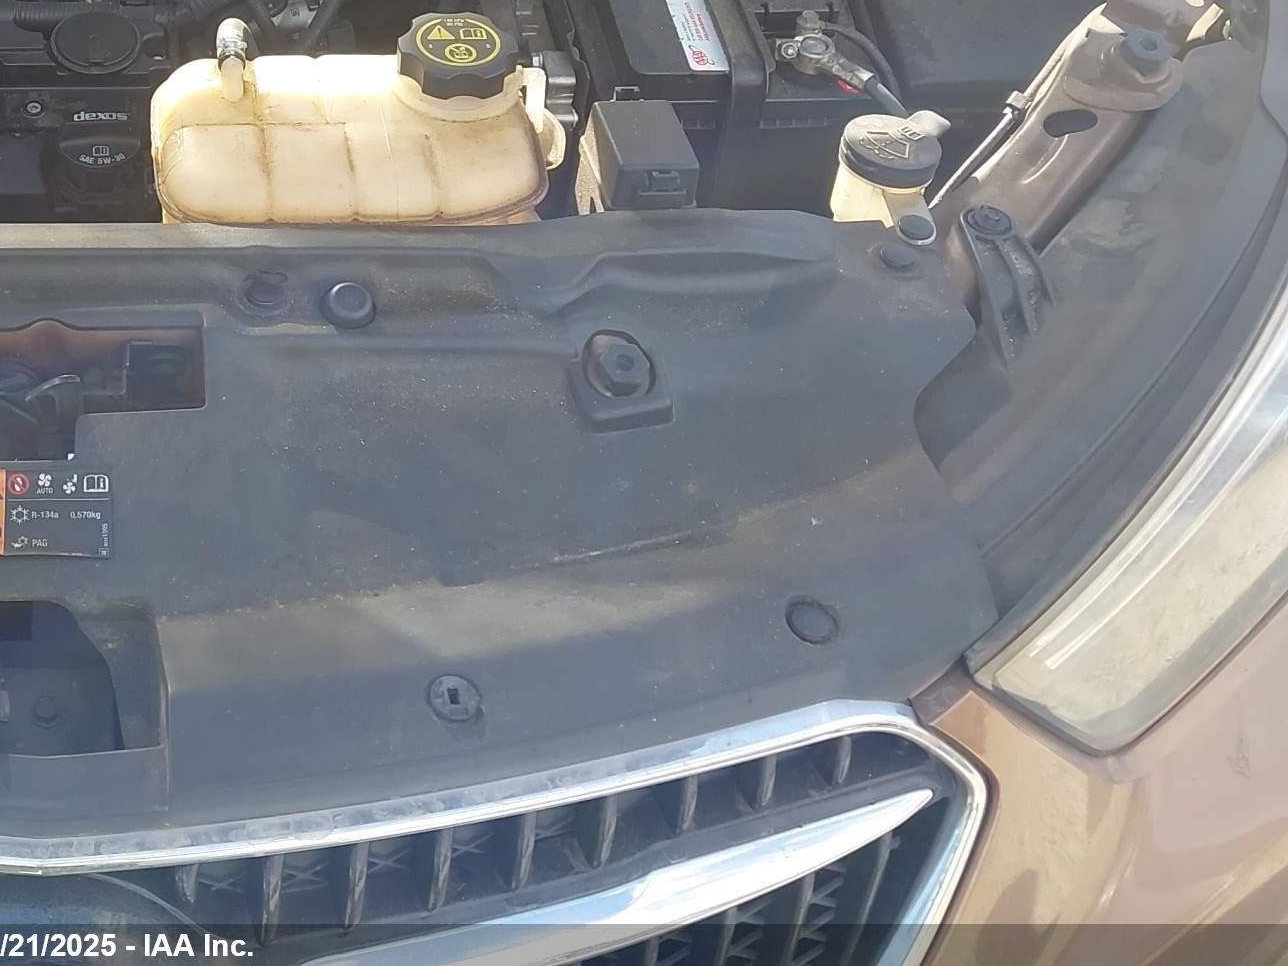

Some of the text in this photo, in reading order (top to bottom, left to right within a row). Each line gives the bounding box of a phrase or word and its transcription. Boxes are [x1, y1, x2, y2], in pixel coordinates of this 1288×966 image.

[73, 110, 128, 121] dexos
[79, 153, 126, 165] SAE 5W-30
[36, 487, 54, 495] AUTO
[31, 510, 59, 519] R-134a
[32, 538, 48, 547] PAG
